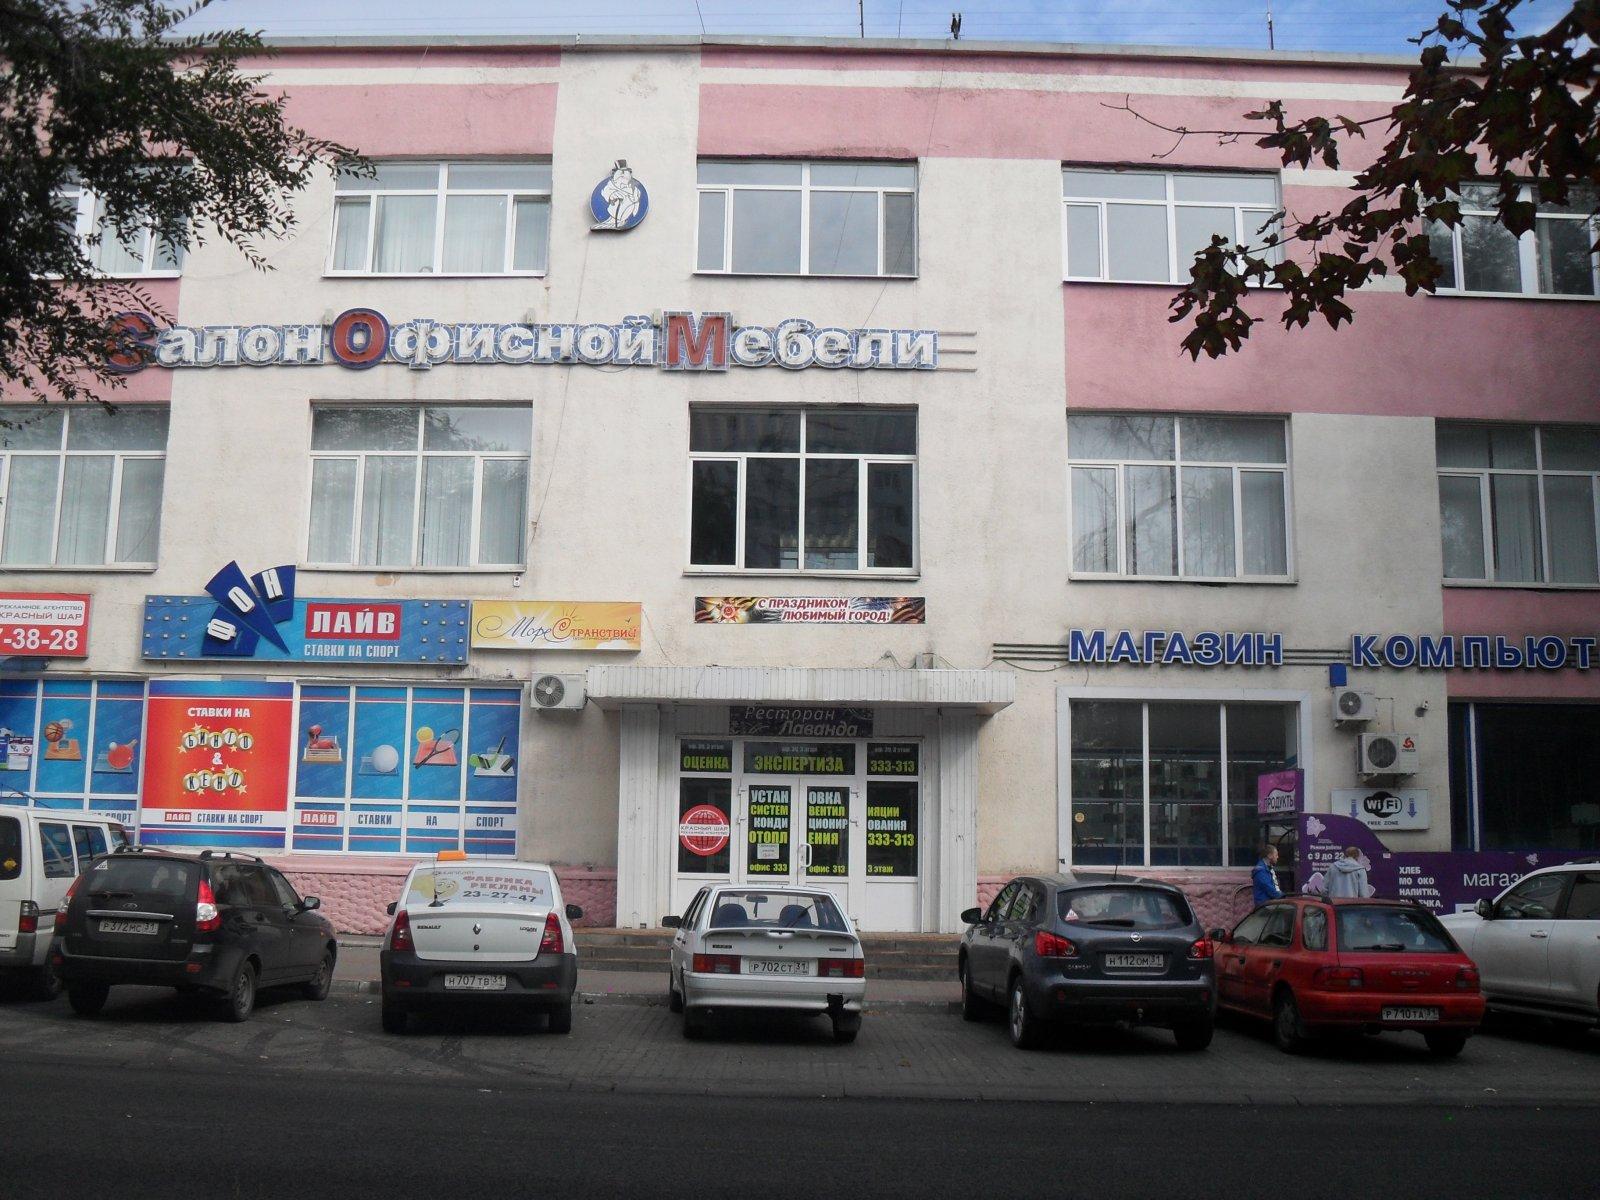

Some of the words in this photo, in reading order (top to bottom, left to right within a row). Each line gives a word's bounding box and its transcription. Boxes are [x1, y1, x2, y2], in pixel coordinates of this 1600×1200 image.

[330, 307, 657, 370] Офисной
[662, 311, 939, 371] Мебели
[758, 599, 766, 609] С
[311, 607, 395, 634] ЛАЙВ
[782, 608, 847, 621] ЛЮБИМЫЙ
[849, 611, 890, 622] ГОРОД!
[0, 628, 78, 650] -38-28
[304, 644, 344, 657] СТАВКИ
[348, 645, 362, 657] НА
[366, 645, 400, 657] СПОРТ
[1069, 629, 1283, 666] МАГАЗИН
[187, 707, 232, 717] СТАВКИ
[234, 708, 251, 718] НА
[744, 706, 836, 723] Ресторан
[779, 720, 859, 737] Лаванда
[186, 730, 251, 749] БИНГО
[212, 752, 223, 765] &
[683, 756, 729, 770] ОЦЕНКА
[754, 756, 844, 772] ЭКСПЕРТИЗА
[870, 760, 915, 772] 333-313
[187, 771, 241, 791] КЕНО
[751, 790, 789, 804] УСТАН
[809, 791, 842, 805] ОВКА
[750, 804, 789, 815] СИСТЕМ
[809, 806, 846, 817] ВЕНТИЛ
[165, 812, 191, 823] ЛАЙВ
[197, 813, 225, 823] СТАВКИ
[227, 813, 238, 823] НА
[240, 814, 263, 824] СПОРТ
[301, 813, 336, 824] ЛАЙВ
[357, 814, 392, 825] СТАВКИ
[426, 816, 437, 826] НА
[476, 816, 505, 827] СПОРТ
[753, 817, 789, 830] КОНДИ
[809, 818, 849, 830] ЦИОНИР
[868, 820, 907, 831] ОВАНИЯ
[748, 831, 788, 844] ОТОПЛ
[808, 832, 839, 845] ЕНИЯ
[868, 833, 915, 847] 333-313
[1322, 853, 1333, 861] до
[750, 864, 771, 873] офис
[773, 864, 788, 872] 333
[809, 865, 830, 874] офис
[833, 865, 846, 873] 313
[867, 865, 873, 873] 3
[874, 865, 894, 873] этаж
[463, 876, 533, 887] ФАБРИКА
[470, 882, 544, 895] РЕКЛАМЫ
[463, 890, 537, 903] 23-27-47
